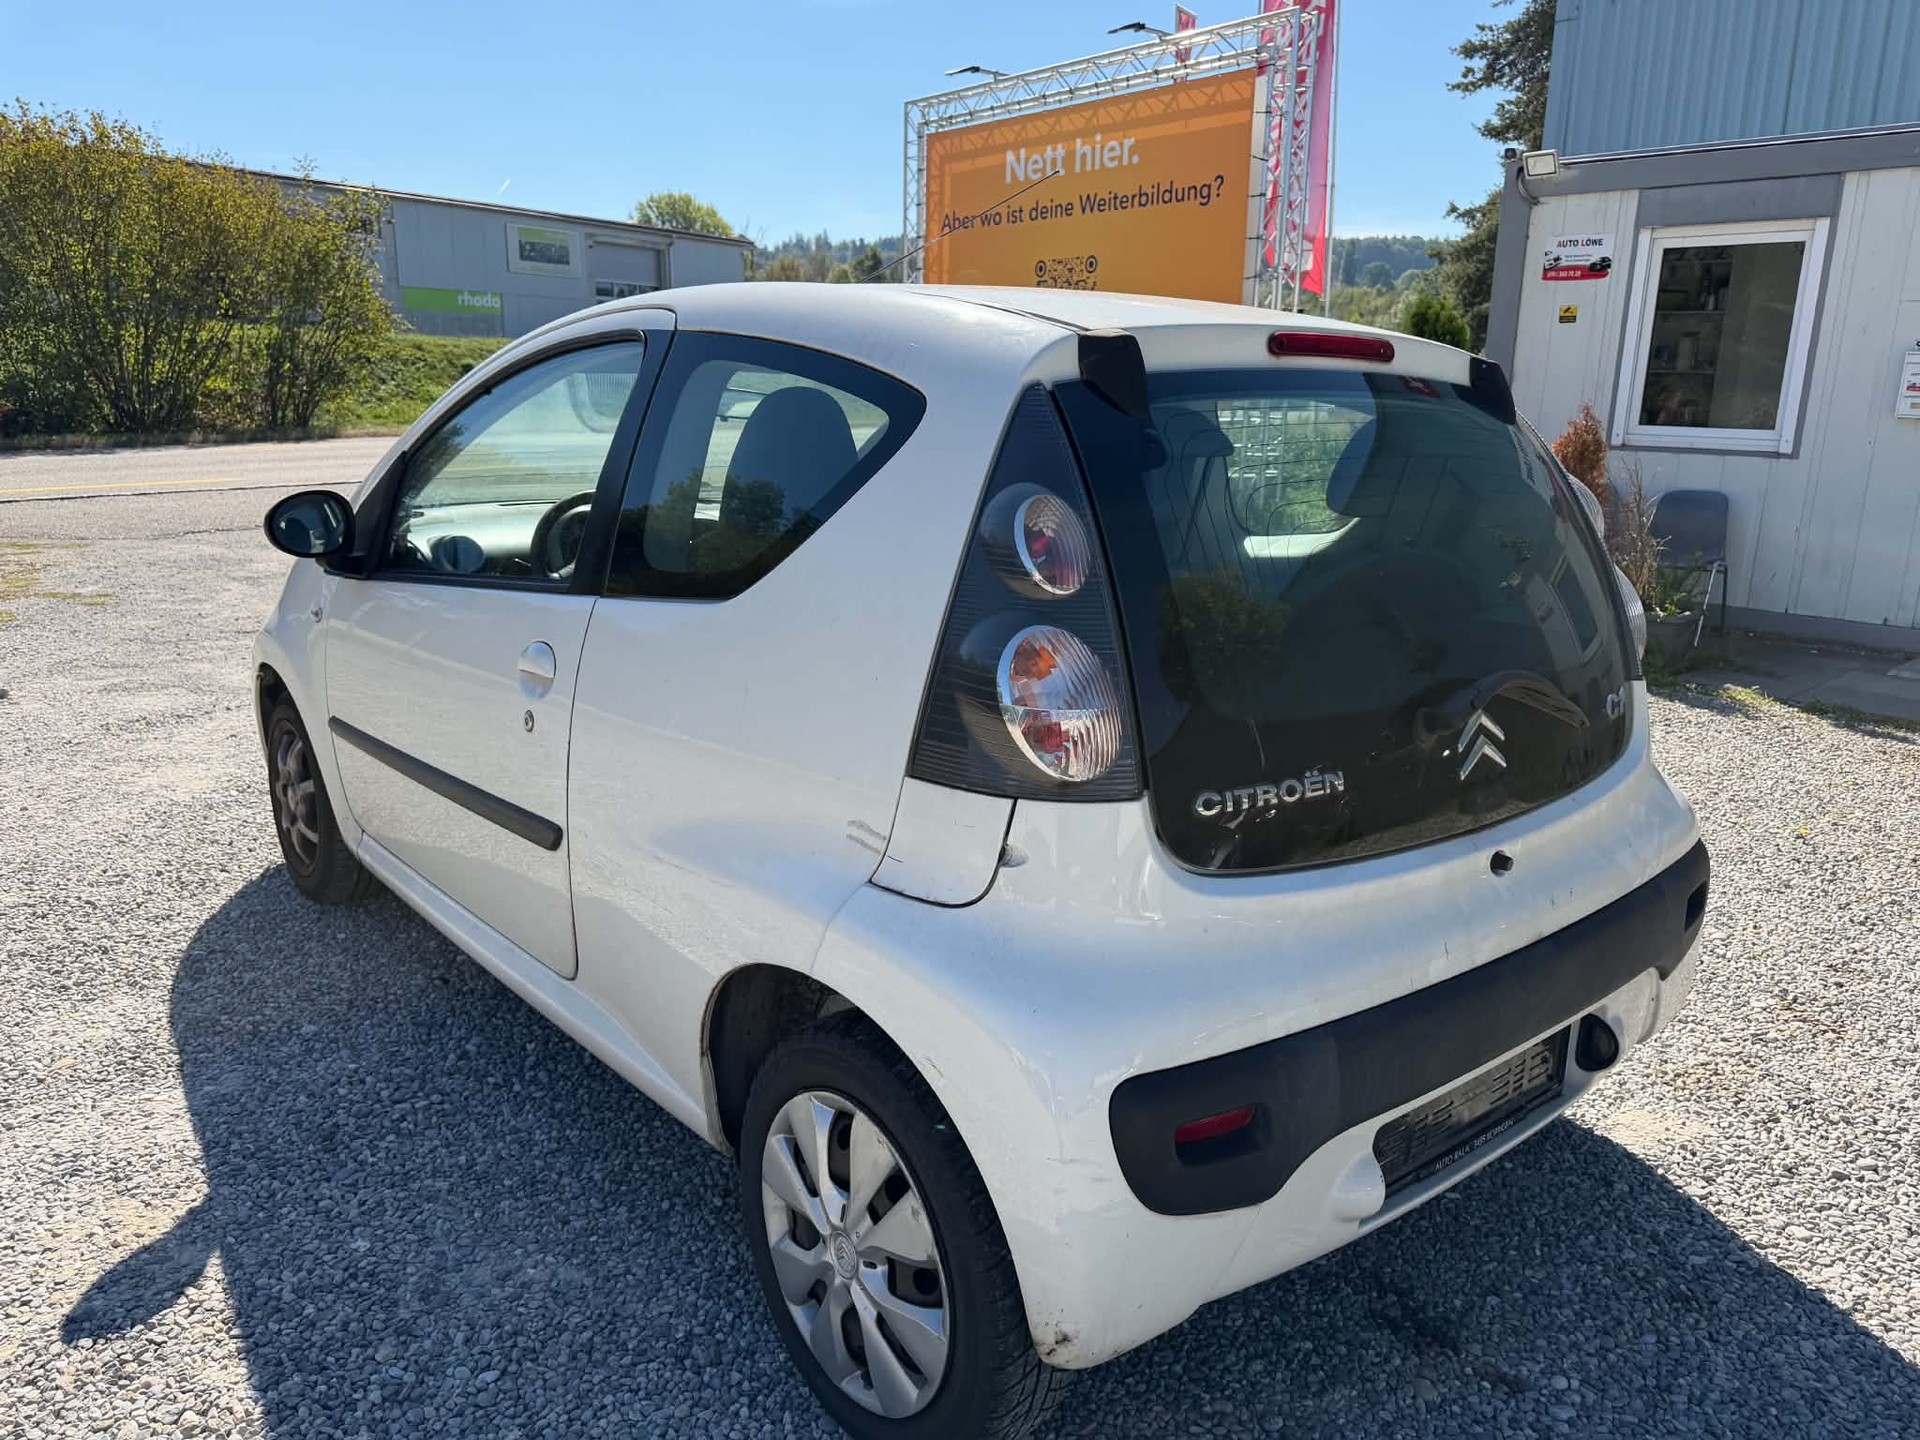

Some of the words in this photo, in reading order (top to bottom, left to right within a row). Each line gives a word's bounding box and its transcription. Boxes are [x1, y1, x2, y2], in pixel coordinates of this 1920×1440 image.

[1004, 143, 1065, 184] Nett
[1075, 132, 1139, 171] hier.
[940, 210, 976, 232] Aber
[980, 211, 1002, 227] wo
[1007, 205, 1024, 224] ist
[1028, 199, 1074, 221] deine
[1079, 174, 1225, 215] Weiterbildung?
[1557, 239, 1579, 248] AUTO
[1195, 770, 1346, 816] CITROËN
